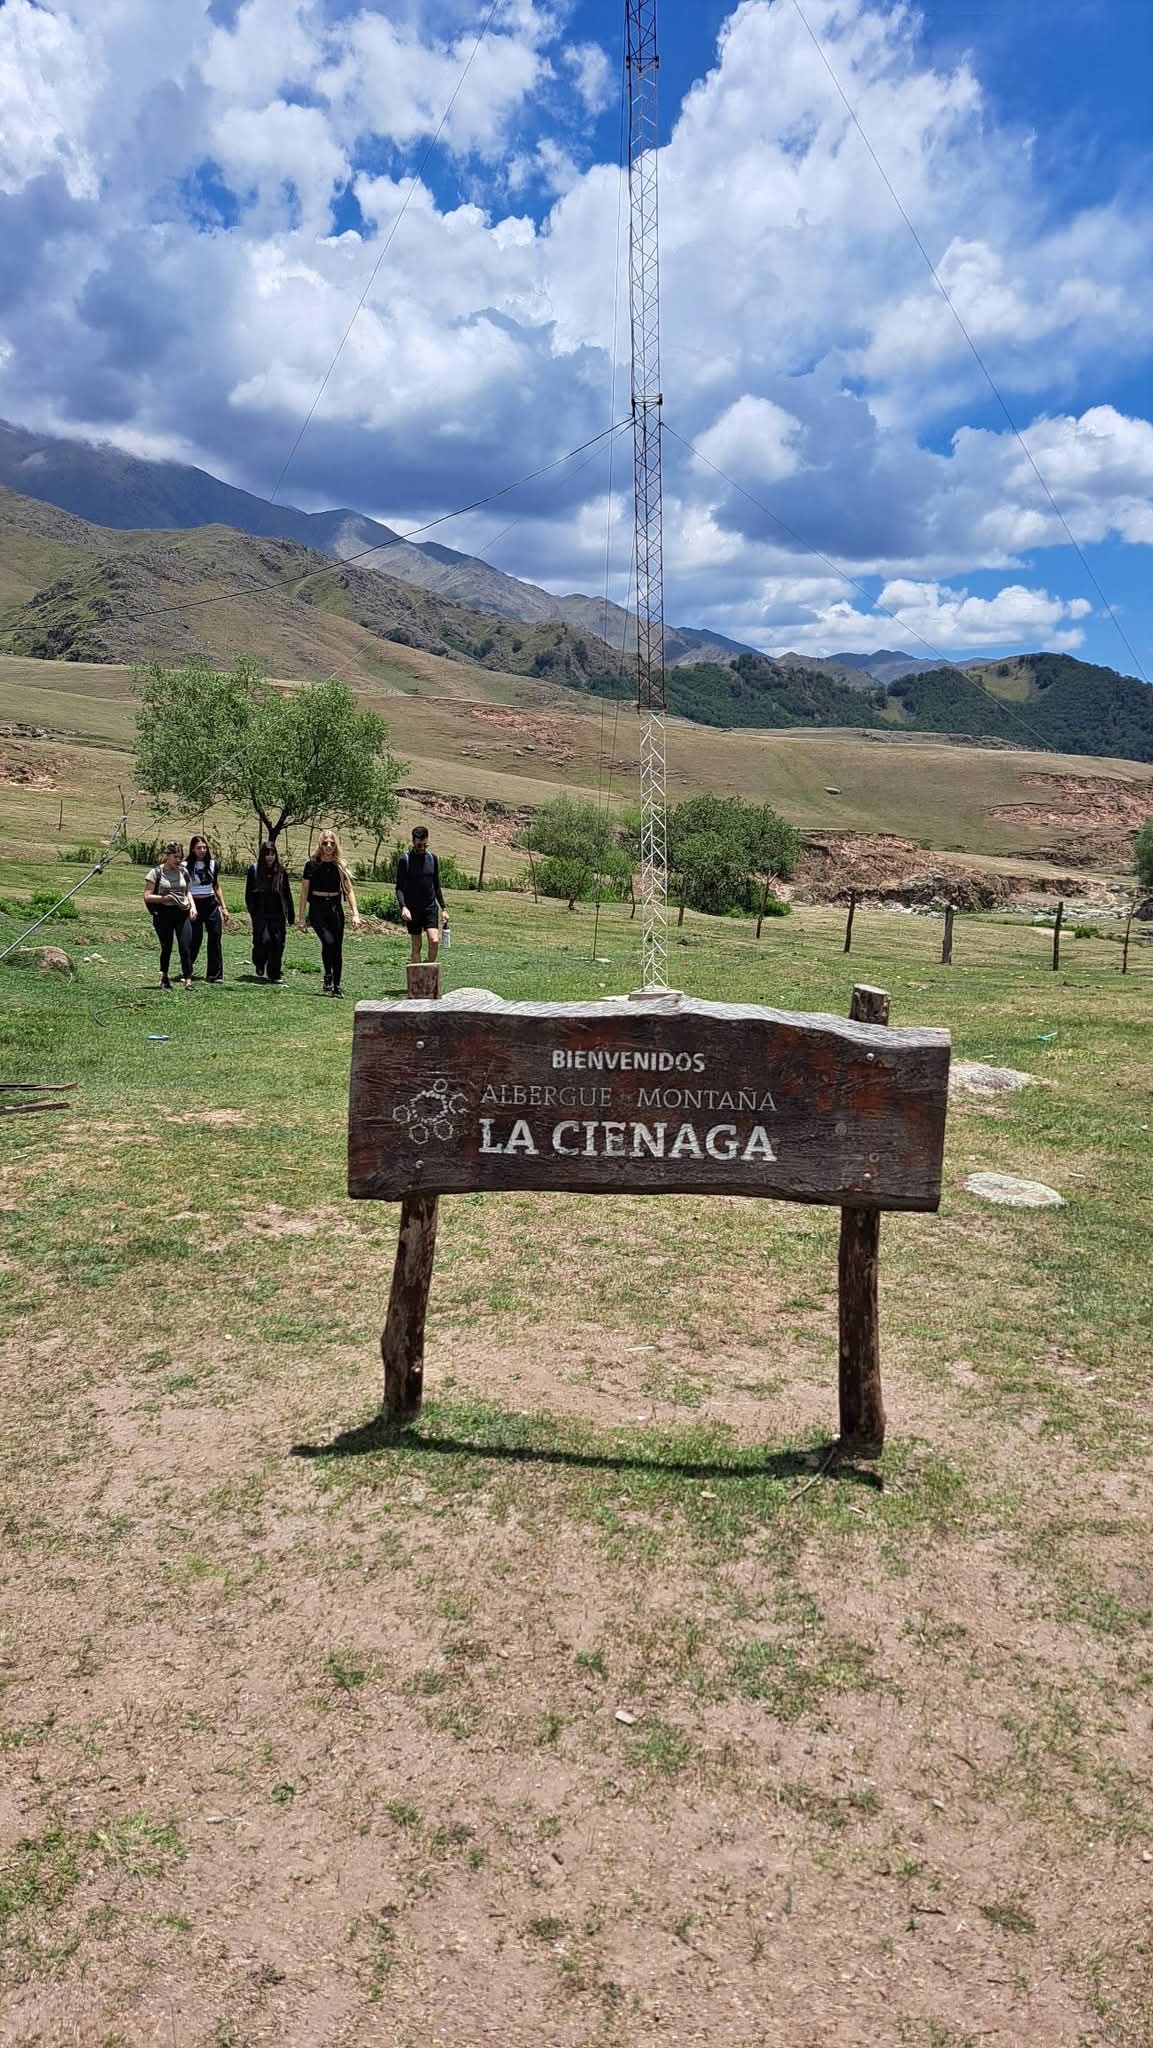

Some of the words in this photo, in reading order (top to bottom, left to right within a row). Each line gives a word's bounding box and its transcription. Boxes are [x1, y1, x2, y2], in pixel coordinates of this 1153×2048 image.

[552, 1050, 705, 1073] BIENVENIDOS
[480, 1084, 612, 1108] ALBERGUE
[636, 1086, 778, 1112] MONTAÑA
[478, 1118, 539, 1155] LA
[552, 1119, 778, 1162] CIENAGA
